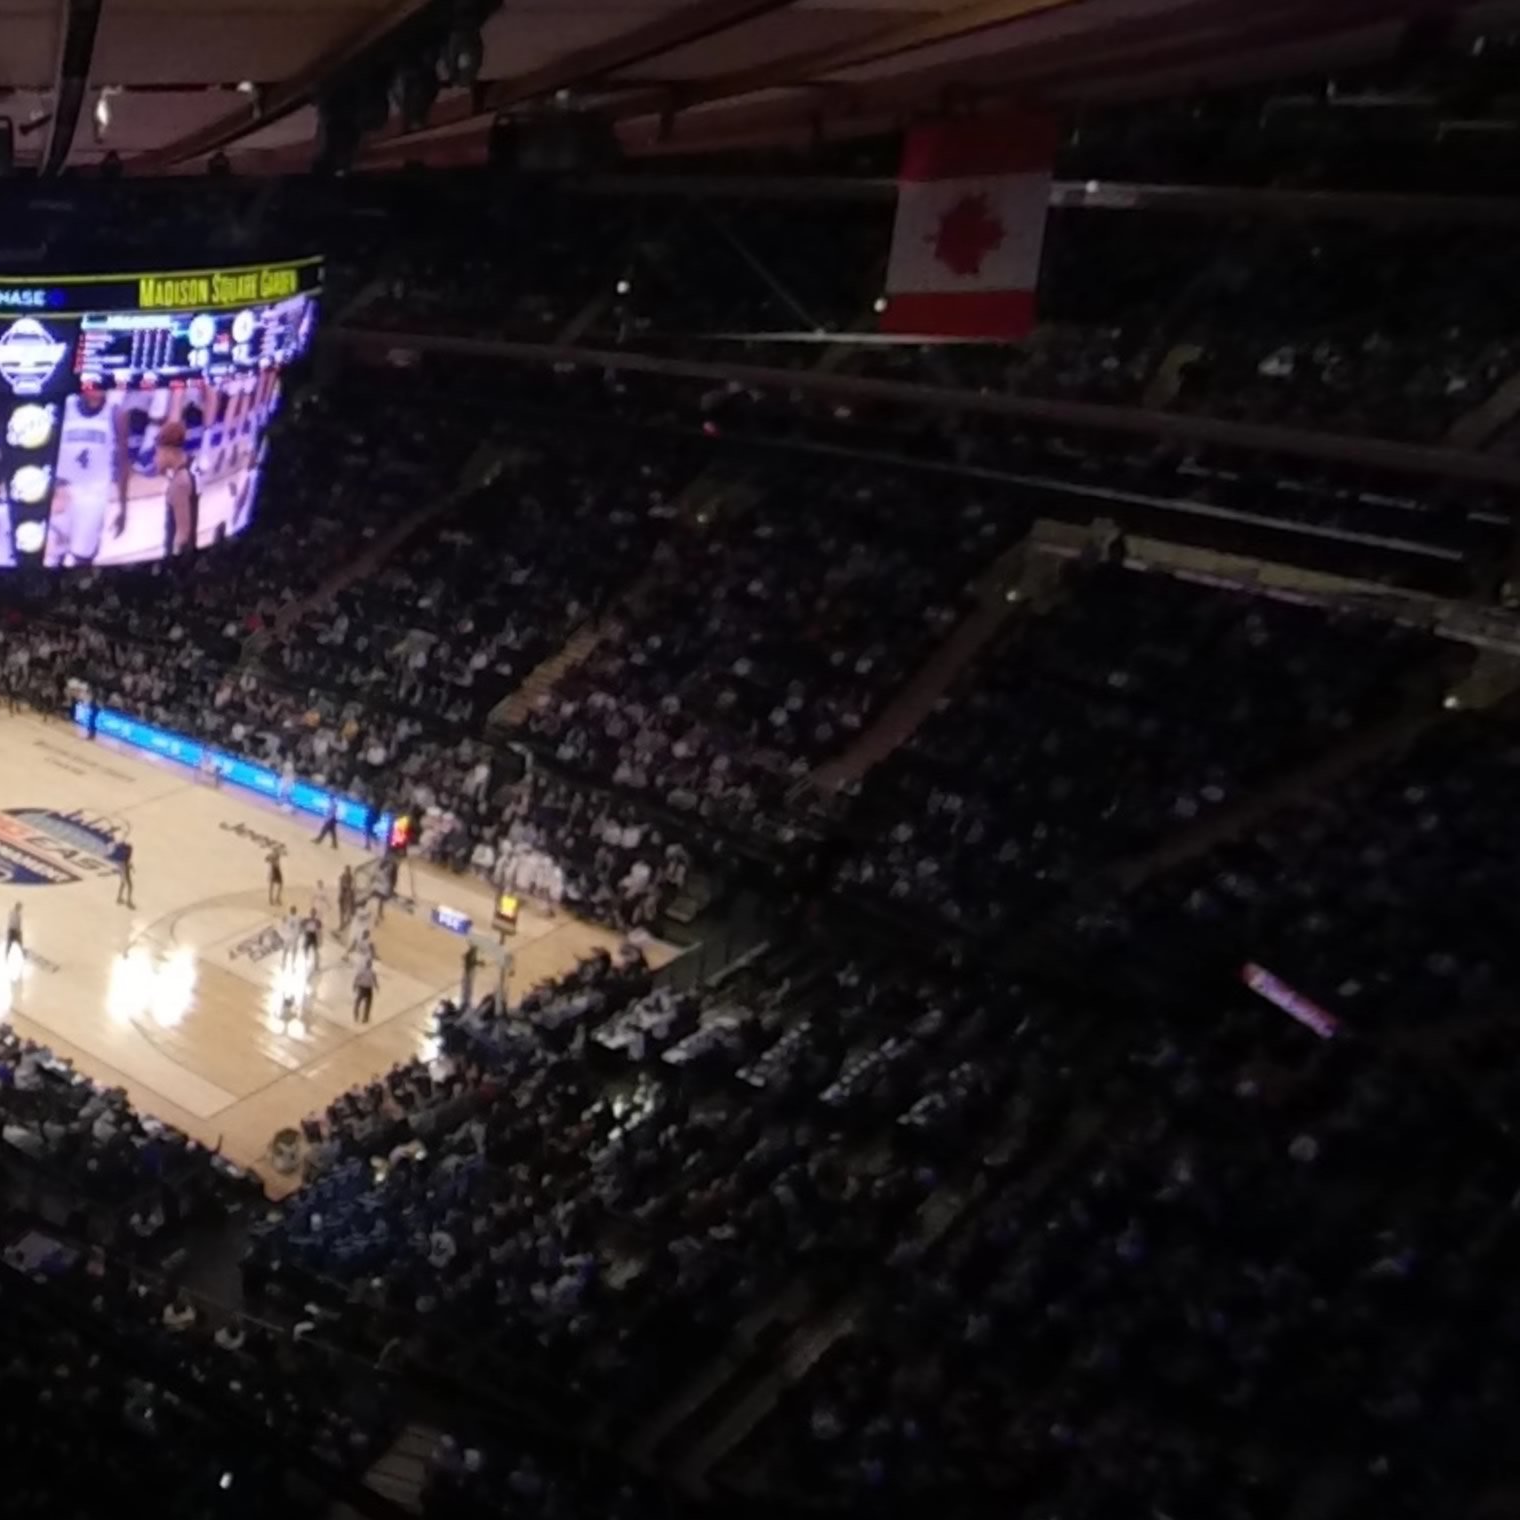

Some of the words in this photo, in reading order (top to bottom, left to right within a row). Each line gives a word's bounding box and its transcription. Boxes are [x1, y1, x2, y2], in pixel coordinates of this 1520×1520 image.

[139, 277, 209, 308] MADISON
[211, 272, 258, 304] SQUARE
[75, 448, 90, 470] 4
